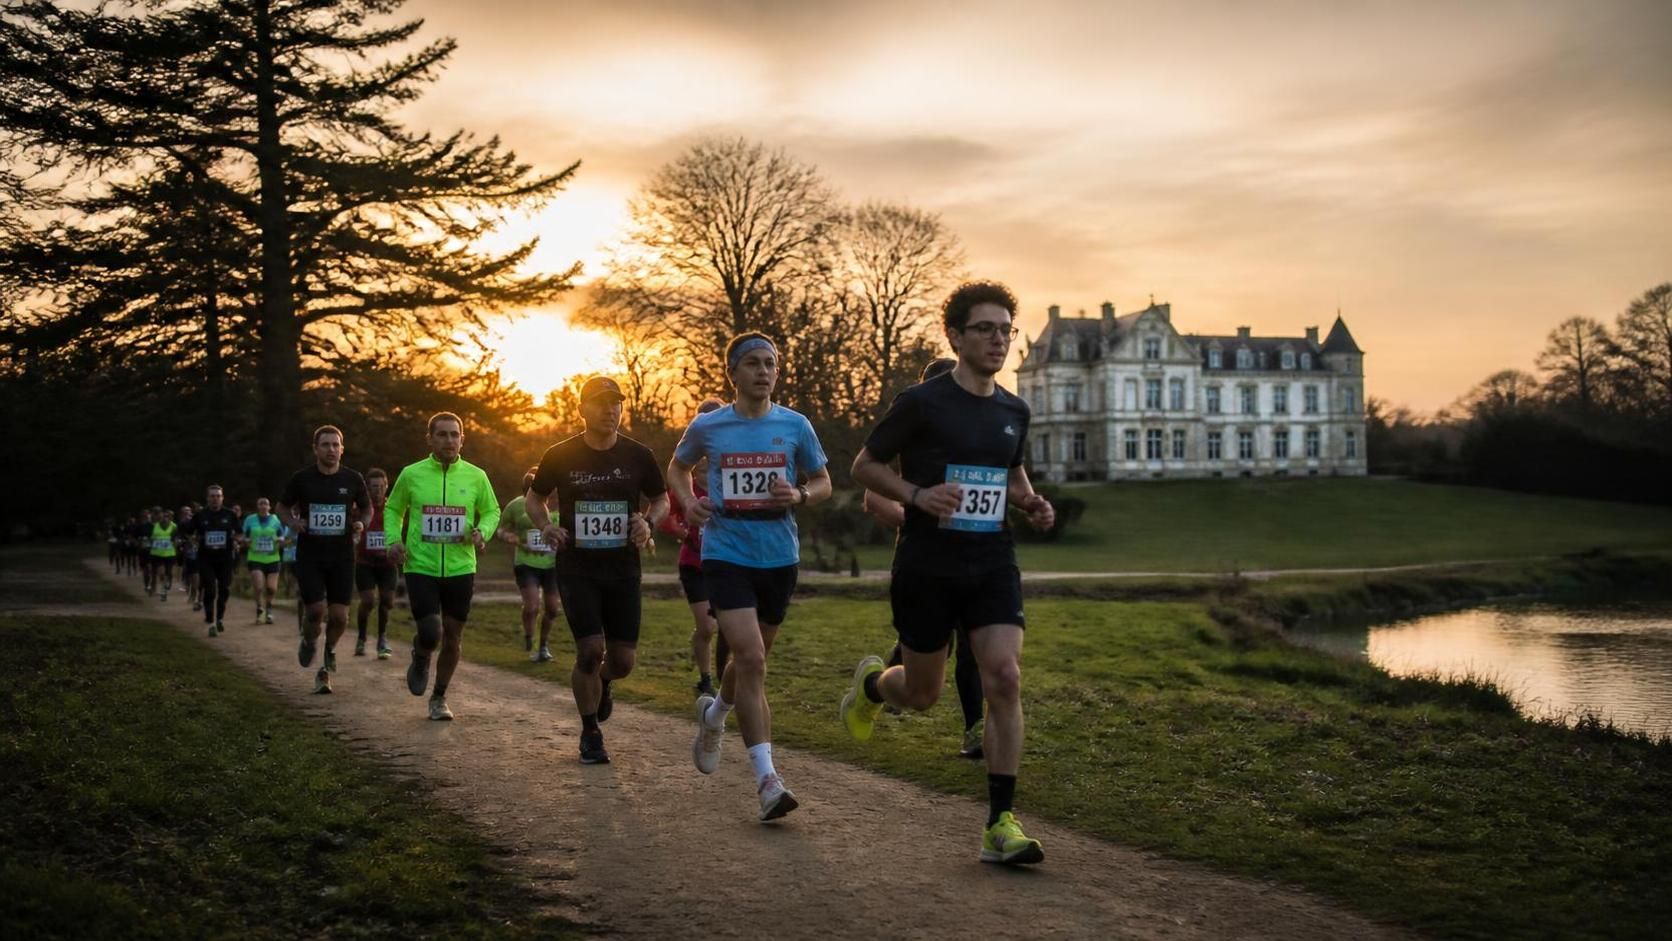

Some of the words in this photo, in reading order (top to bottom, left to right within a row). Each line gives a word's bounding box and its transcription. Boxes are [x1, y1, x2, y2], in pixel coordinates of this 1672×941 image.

[313, 513, 342, 527] 1259
[427, 516, 460, 533] 1181
[582, 516, 622, 536] 1348
